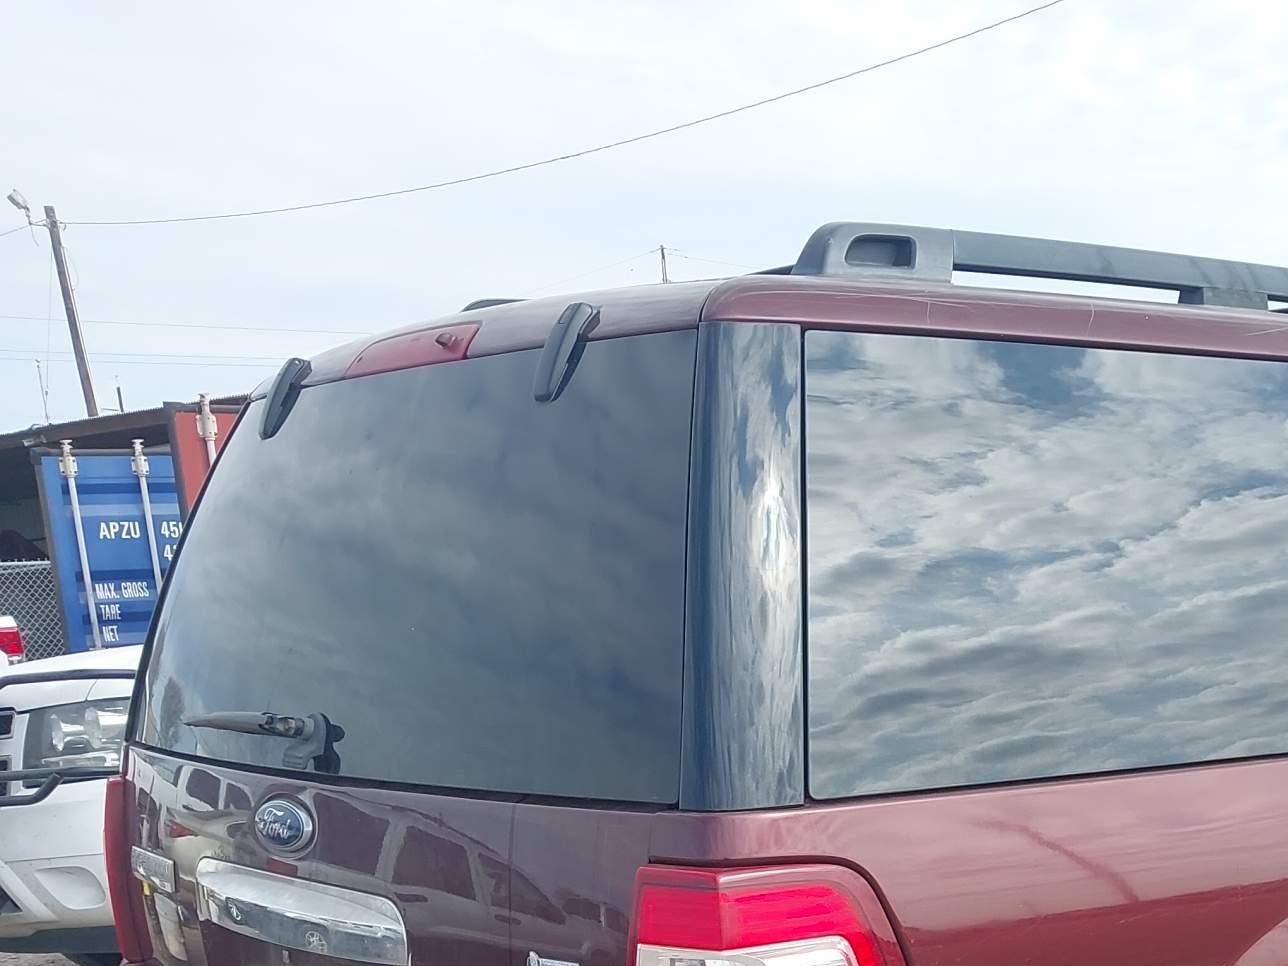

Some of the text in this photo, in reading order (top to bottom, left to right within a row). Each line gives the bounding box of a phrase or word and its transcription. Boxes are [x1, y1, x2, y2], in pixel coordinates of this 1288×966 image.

[99, 521, 141, 539] APZU
[94, 581, 150, 600] MAX. GROSS
[99, 603, 122, 620] TARE
[102, 625, 119, 642] NET
[262, 807, 292, 840] Ford
